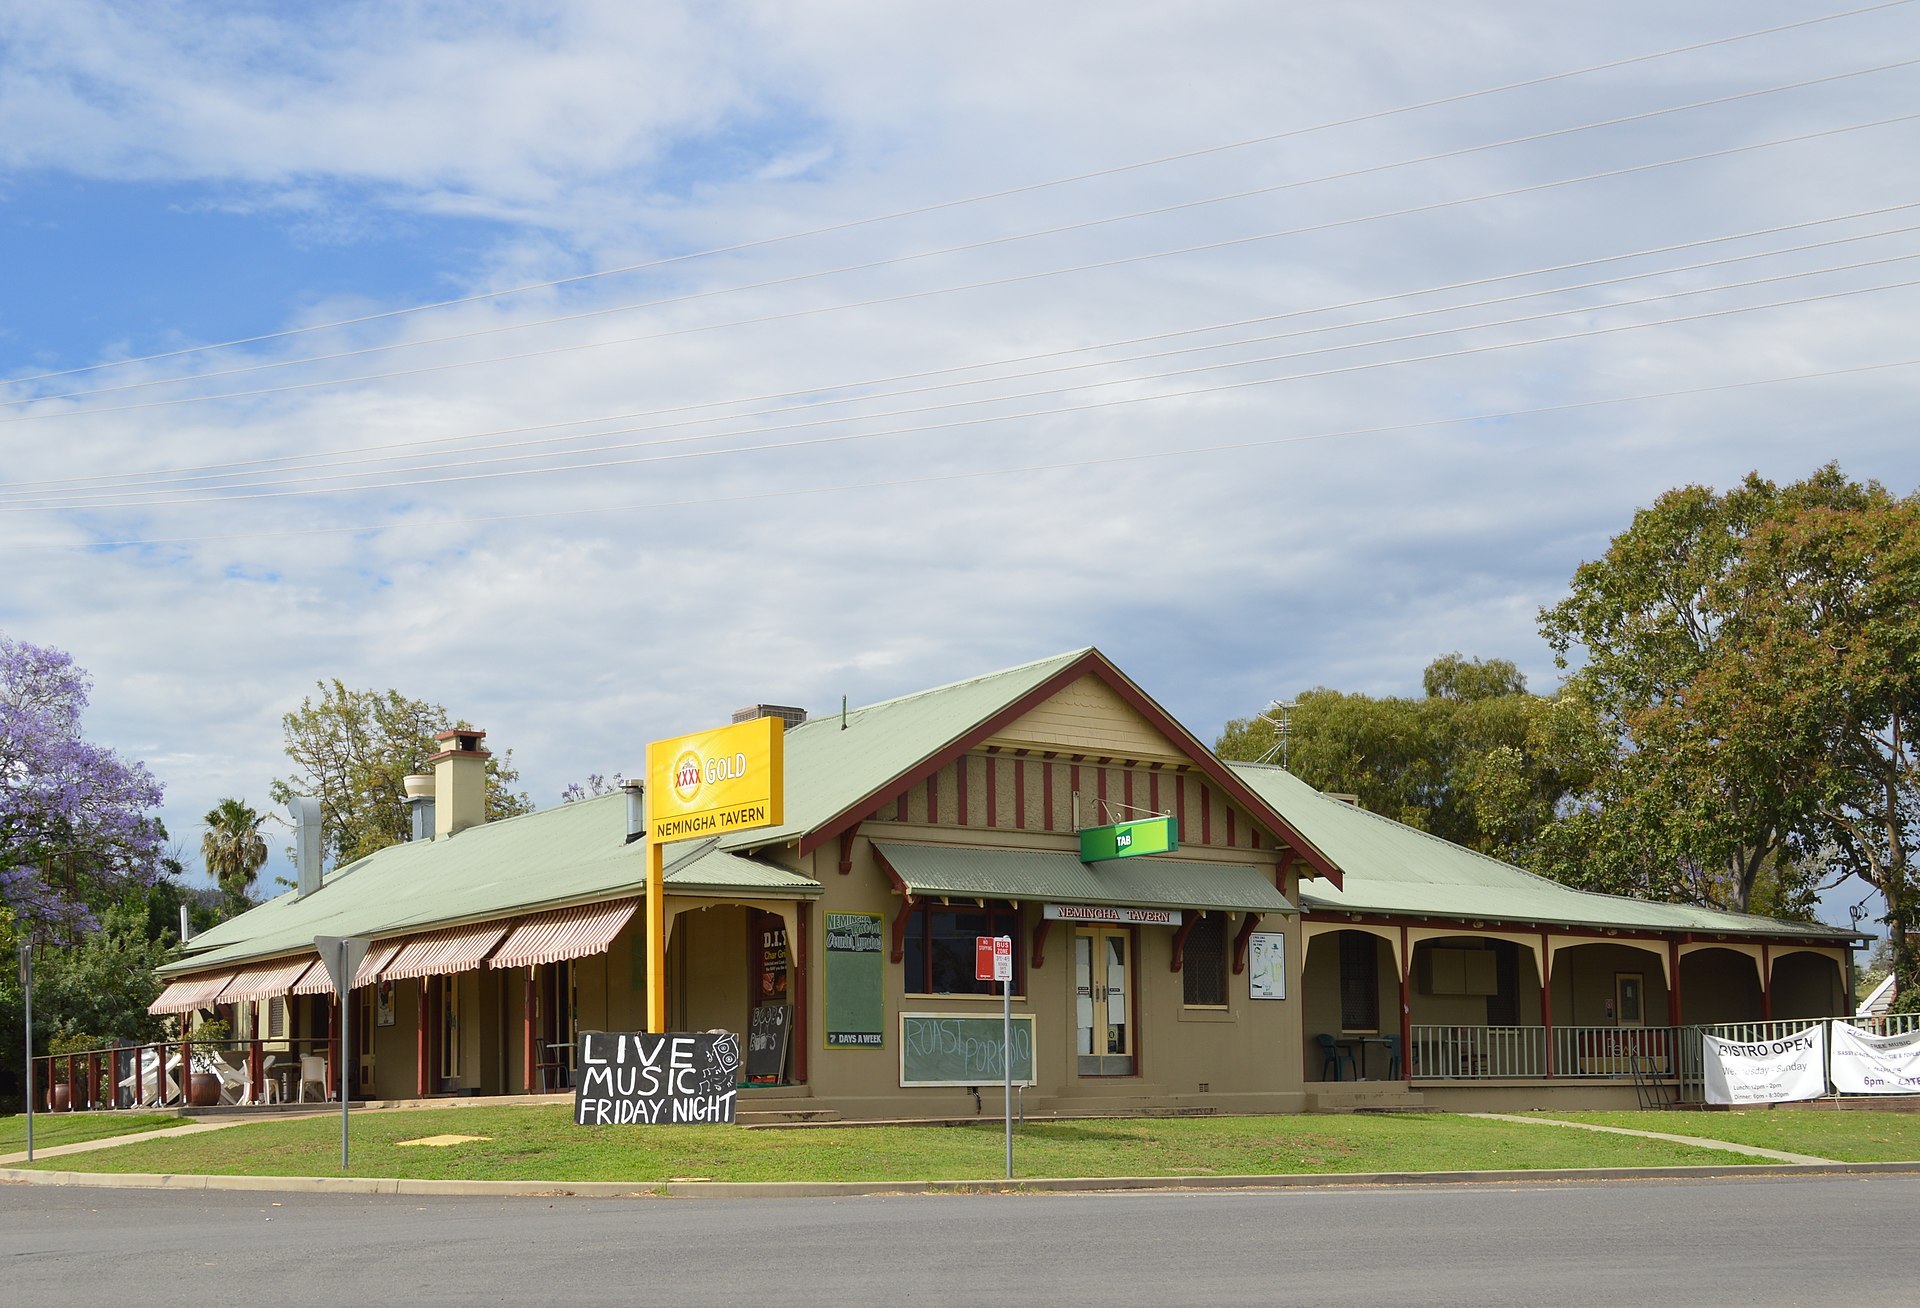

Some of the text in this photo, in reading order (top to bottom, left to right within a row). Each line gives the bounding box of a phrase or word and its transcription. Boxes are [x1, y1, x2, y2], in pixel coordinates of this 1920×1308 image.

[675, 769, 701, 787] XXXX
[705, 752, 746, 785] GOLD
[657, 806, 765, 837] NEMINGHA TAVERN
[1116, 835, 1131, 847] TAB
[827, 914, 872, 930] NEMINGHA
[1058, 907, 1171, 922] NEMINGHA TAVERN
[830, 1034, 882, 1043] 7 DAYS A WEEK
[906, 1019, 965, 1056] ROAST
[1718, 1037, 1813, 1057] BISTRO OPEN
[1889, 1040, 1911, 1048] MUSIC
[584, 1035, 695, 1068] LIVE
[965, 1037, 1006, 1076] PORK
[583, 1066, 696, 1097] MUSIC
[1769, 1082, 1782, 1090] 2pm
[1864, 1076, 1884, 1087] 6pm
[580, 1090, 736, 1125] FRIDAY NIGHT
